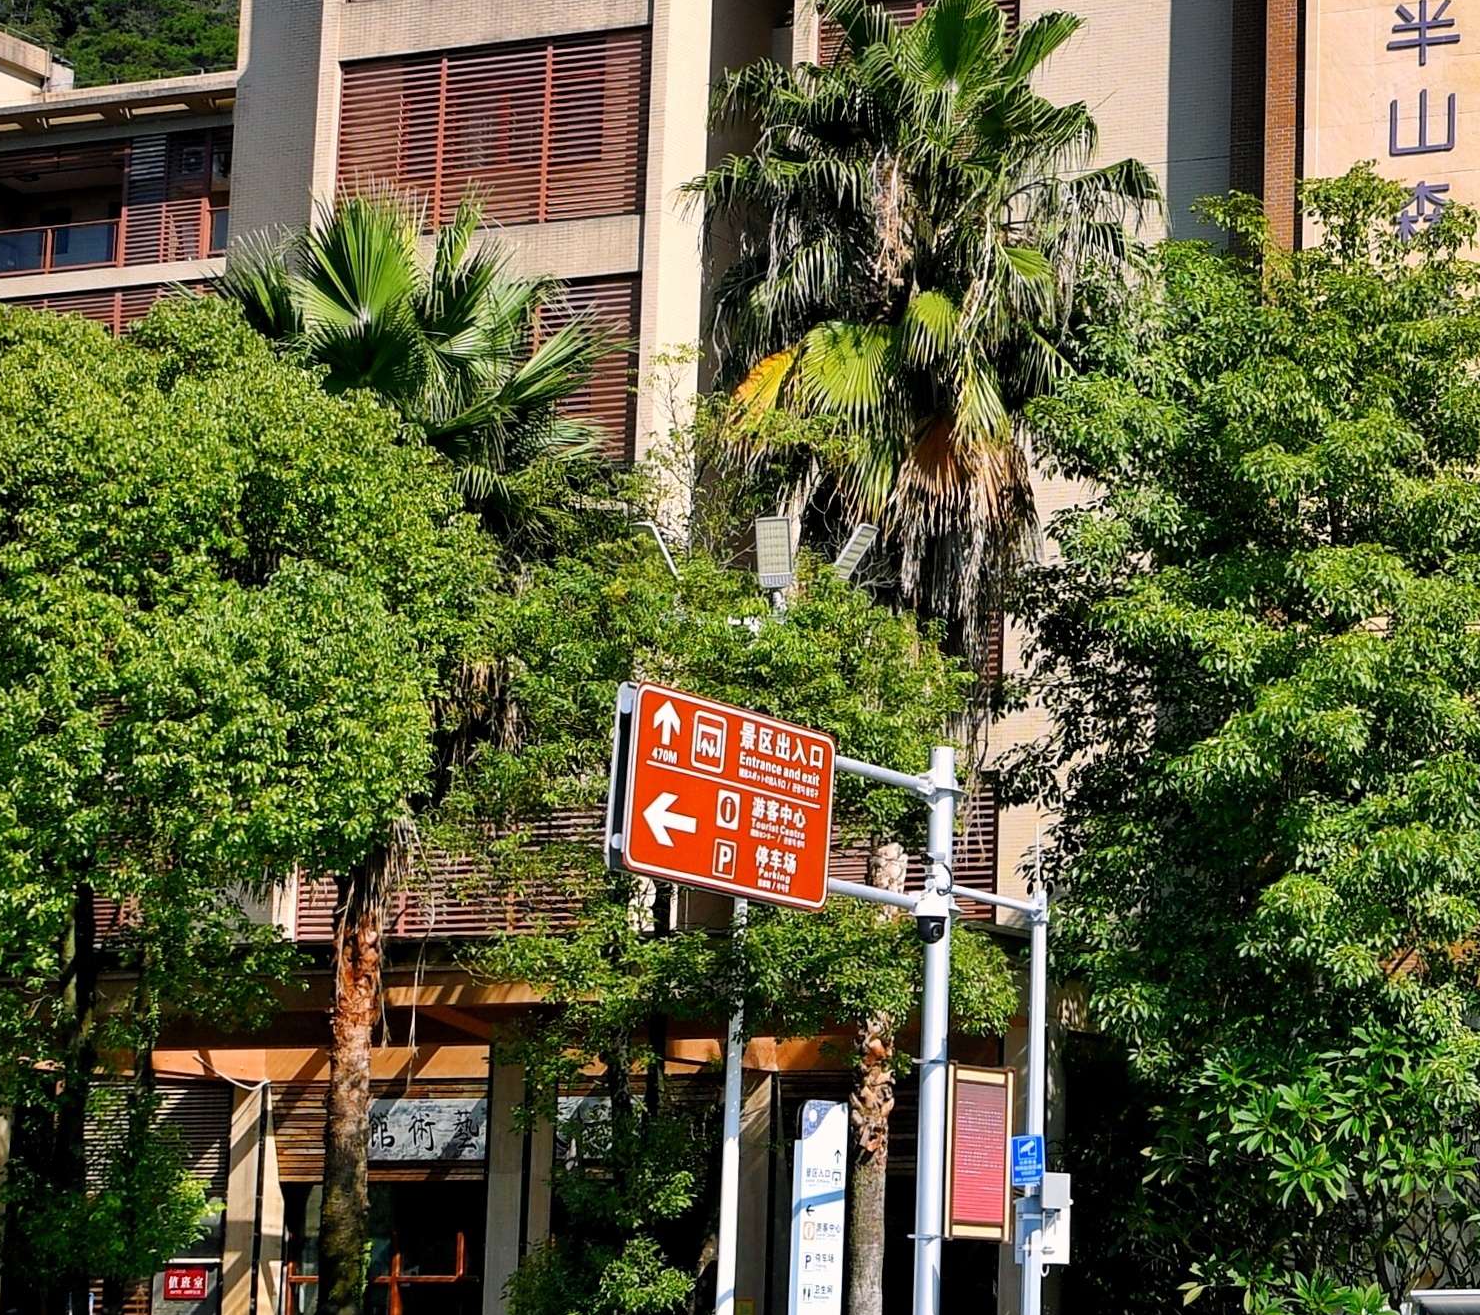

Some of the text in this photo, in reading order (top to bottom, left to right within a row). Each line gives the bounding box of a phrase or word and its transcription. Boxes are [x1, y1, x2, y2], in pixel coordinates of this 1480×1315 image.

[652, 747, 677, 765] 470M
[740, 721, 824, 769] 景区出入口
[740, 752, 820, 787] Entrance and exit
[751, 796, 806, 828] 游客中心
[751, 818, 805, 839] Tourist Centre
[718, 845, 732, 872] P
[755, 845, 797, 874] 停车场
[758, 868, 791, 884] Parking
